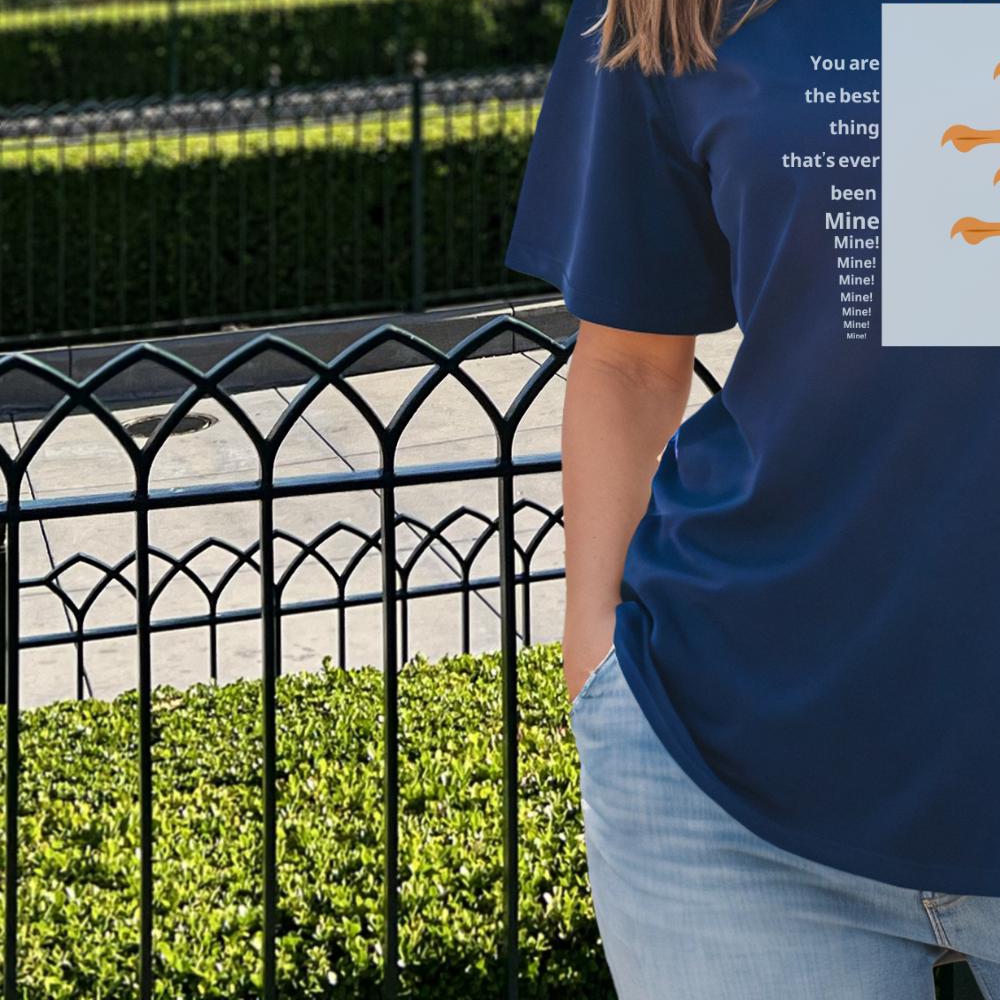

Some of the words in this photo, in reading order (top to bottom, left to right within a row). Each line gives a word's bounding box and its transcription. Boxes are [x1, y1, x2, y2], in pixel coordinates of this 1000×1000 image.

[809, 55, 846, 71] You
[849, 57, 880, 71] are
[804, 87, 837, 104] the
[840, 87, 880, 104] best
[829, 119, 879, 140] thing
[781, 151, 836, 168] that's
[838, 155, 880, 168] ever
[831, 184, 877, 201] been
[825, 211, 880, 230] Mine
[834, 234, 879, 249] Mine!
[837, 256, 876, 269] Mine!
[839, 274, 875, 286] Mine!
[840, 291, 873, 302] Mine!
[842, 306, 872, 317] Mine!
[843, 319, 870, 329] Mine!
[846, 332, 867, 340] Mine!
